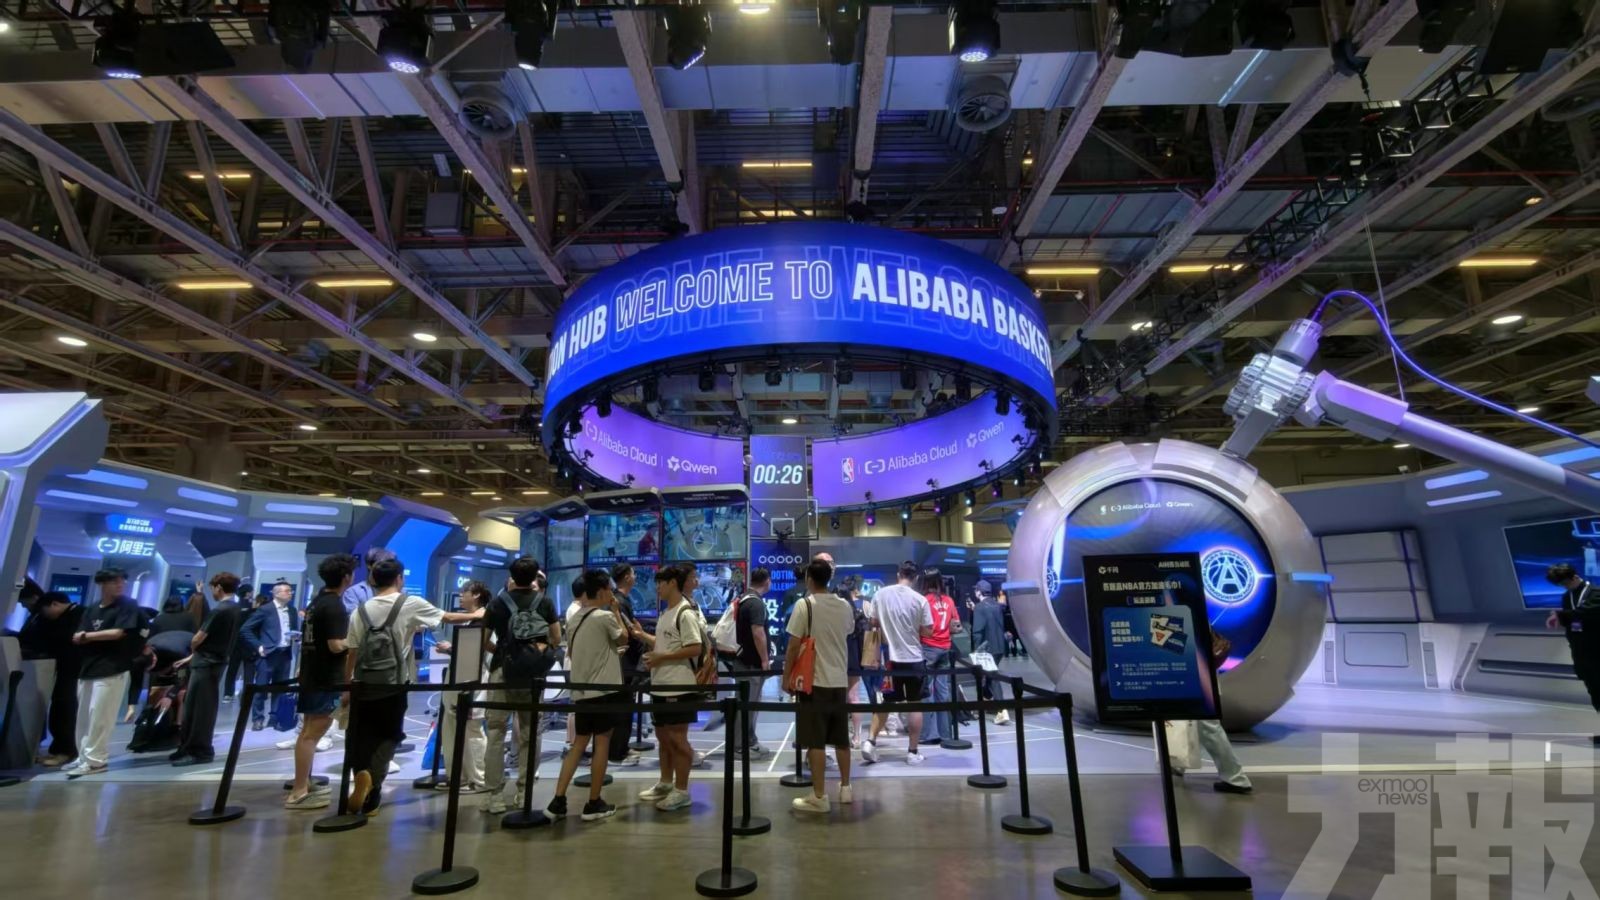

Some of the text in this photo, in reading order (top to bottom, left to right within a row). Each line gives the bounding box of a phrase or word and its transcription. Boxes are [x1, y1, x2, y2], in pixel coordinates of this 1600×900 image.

[568, 304, 608, 359] HUB
[615, 262, 773, 333] WELCOME
[784, 260, 833, 300] TO
[852, 262, 988, 329] ALIBABA
[977, 421, 1005, 446] Qwen
[599, 431, 658, 467] Alibaba Cloud
[887, 440, 958, 472] Alibaba Cloud
[681, 460, 717, 475] Qwen
[753, 463, 804, 485] 00:26
[119, 539, 156, 557] 阿里云
